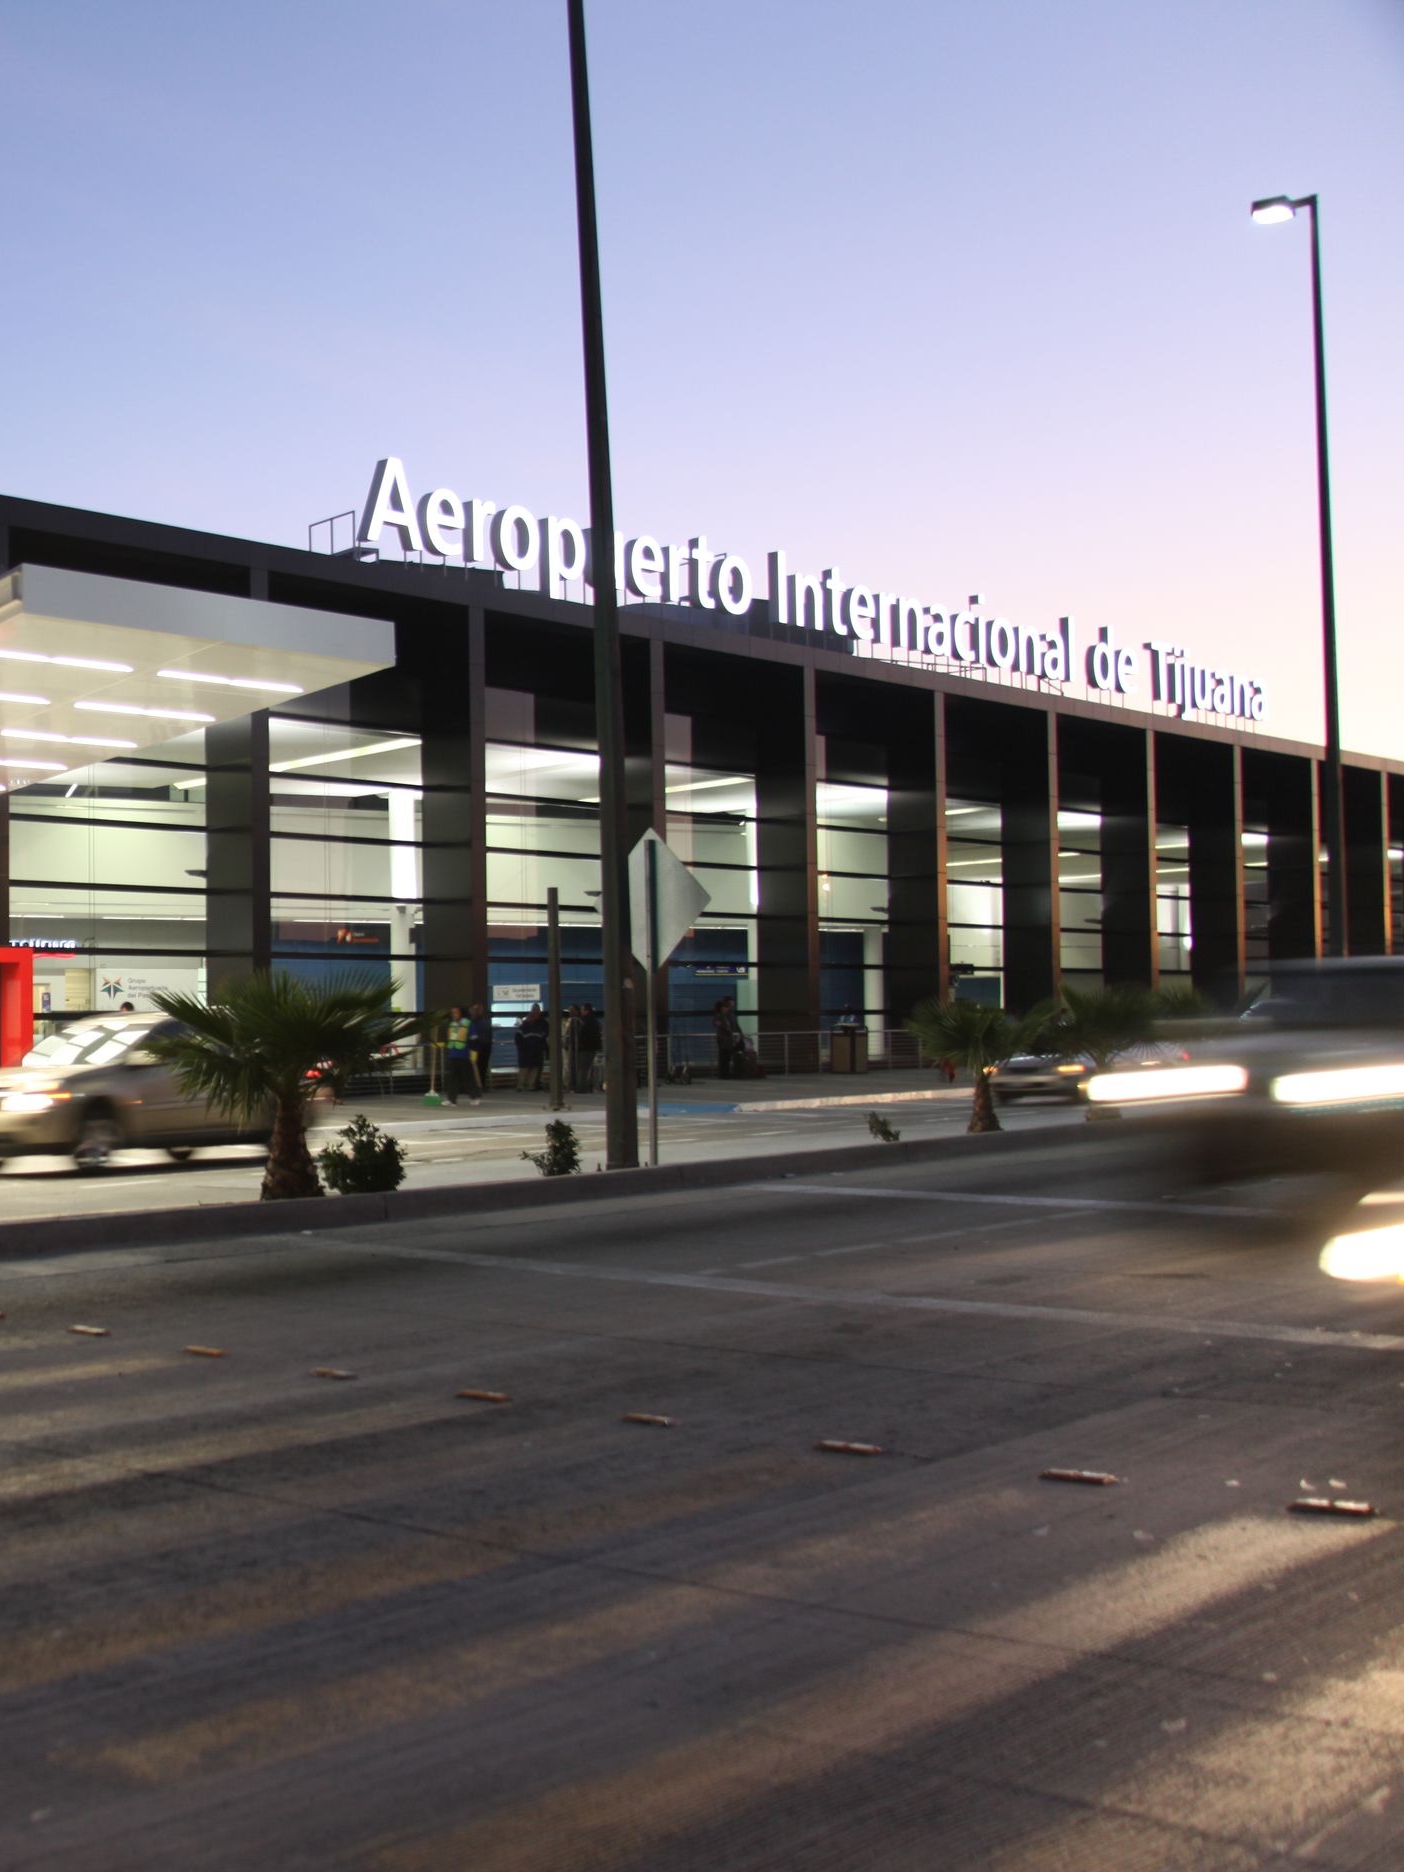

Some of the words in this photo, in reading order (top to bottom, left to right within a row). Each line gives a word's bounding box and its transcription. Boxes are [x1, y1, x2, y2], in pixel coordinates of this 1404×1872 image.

[768, 549, 1077, 683] Internacional
[1087, 625, 1140, 693] de
[1144, 641, 1270, 722] Tijuana
